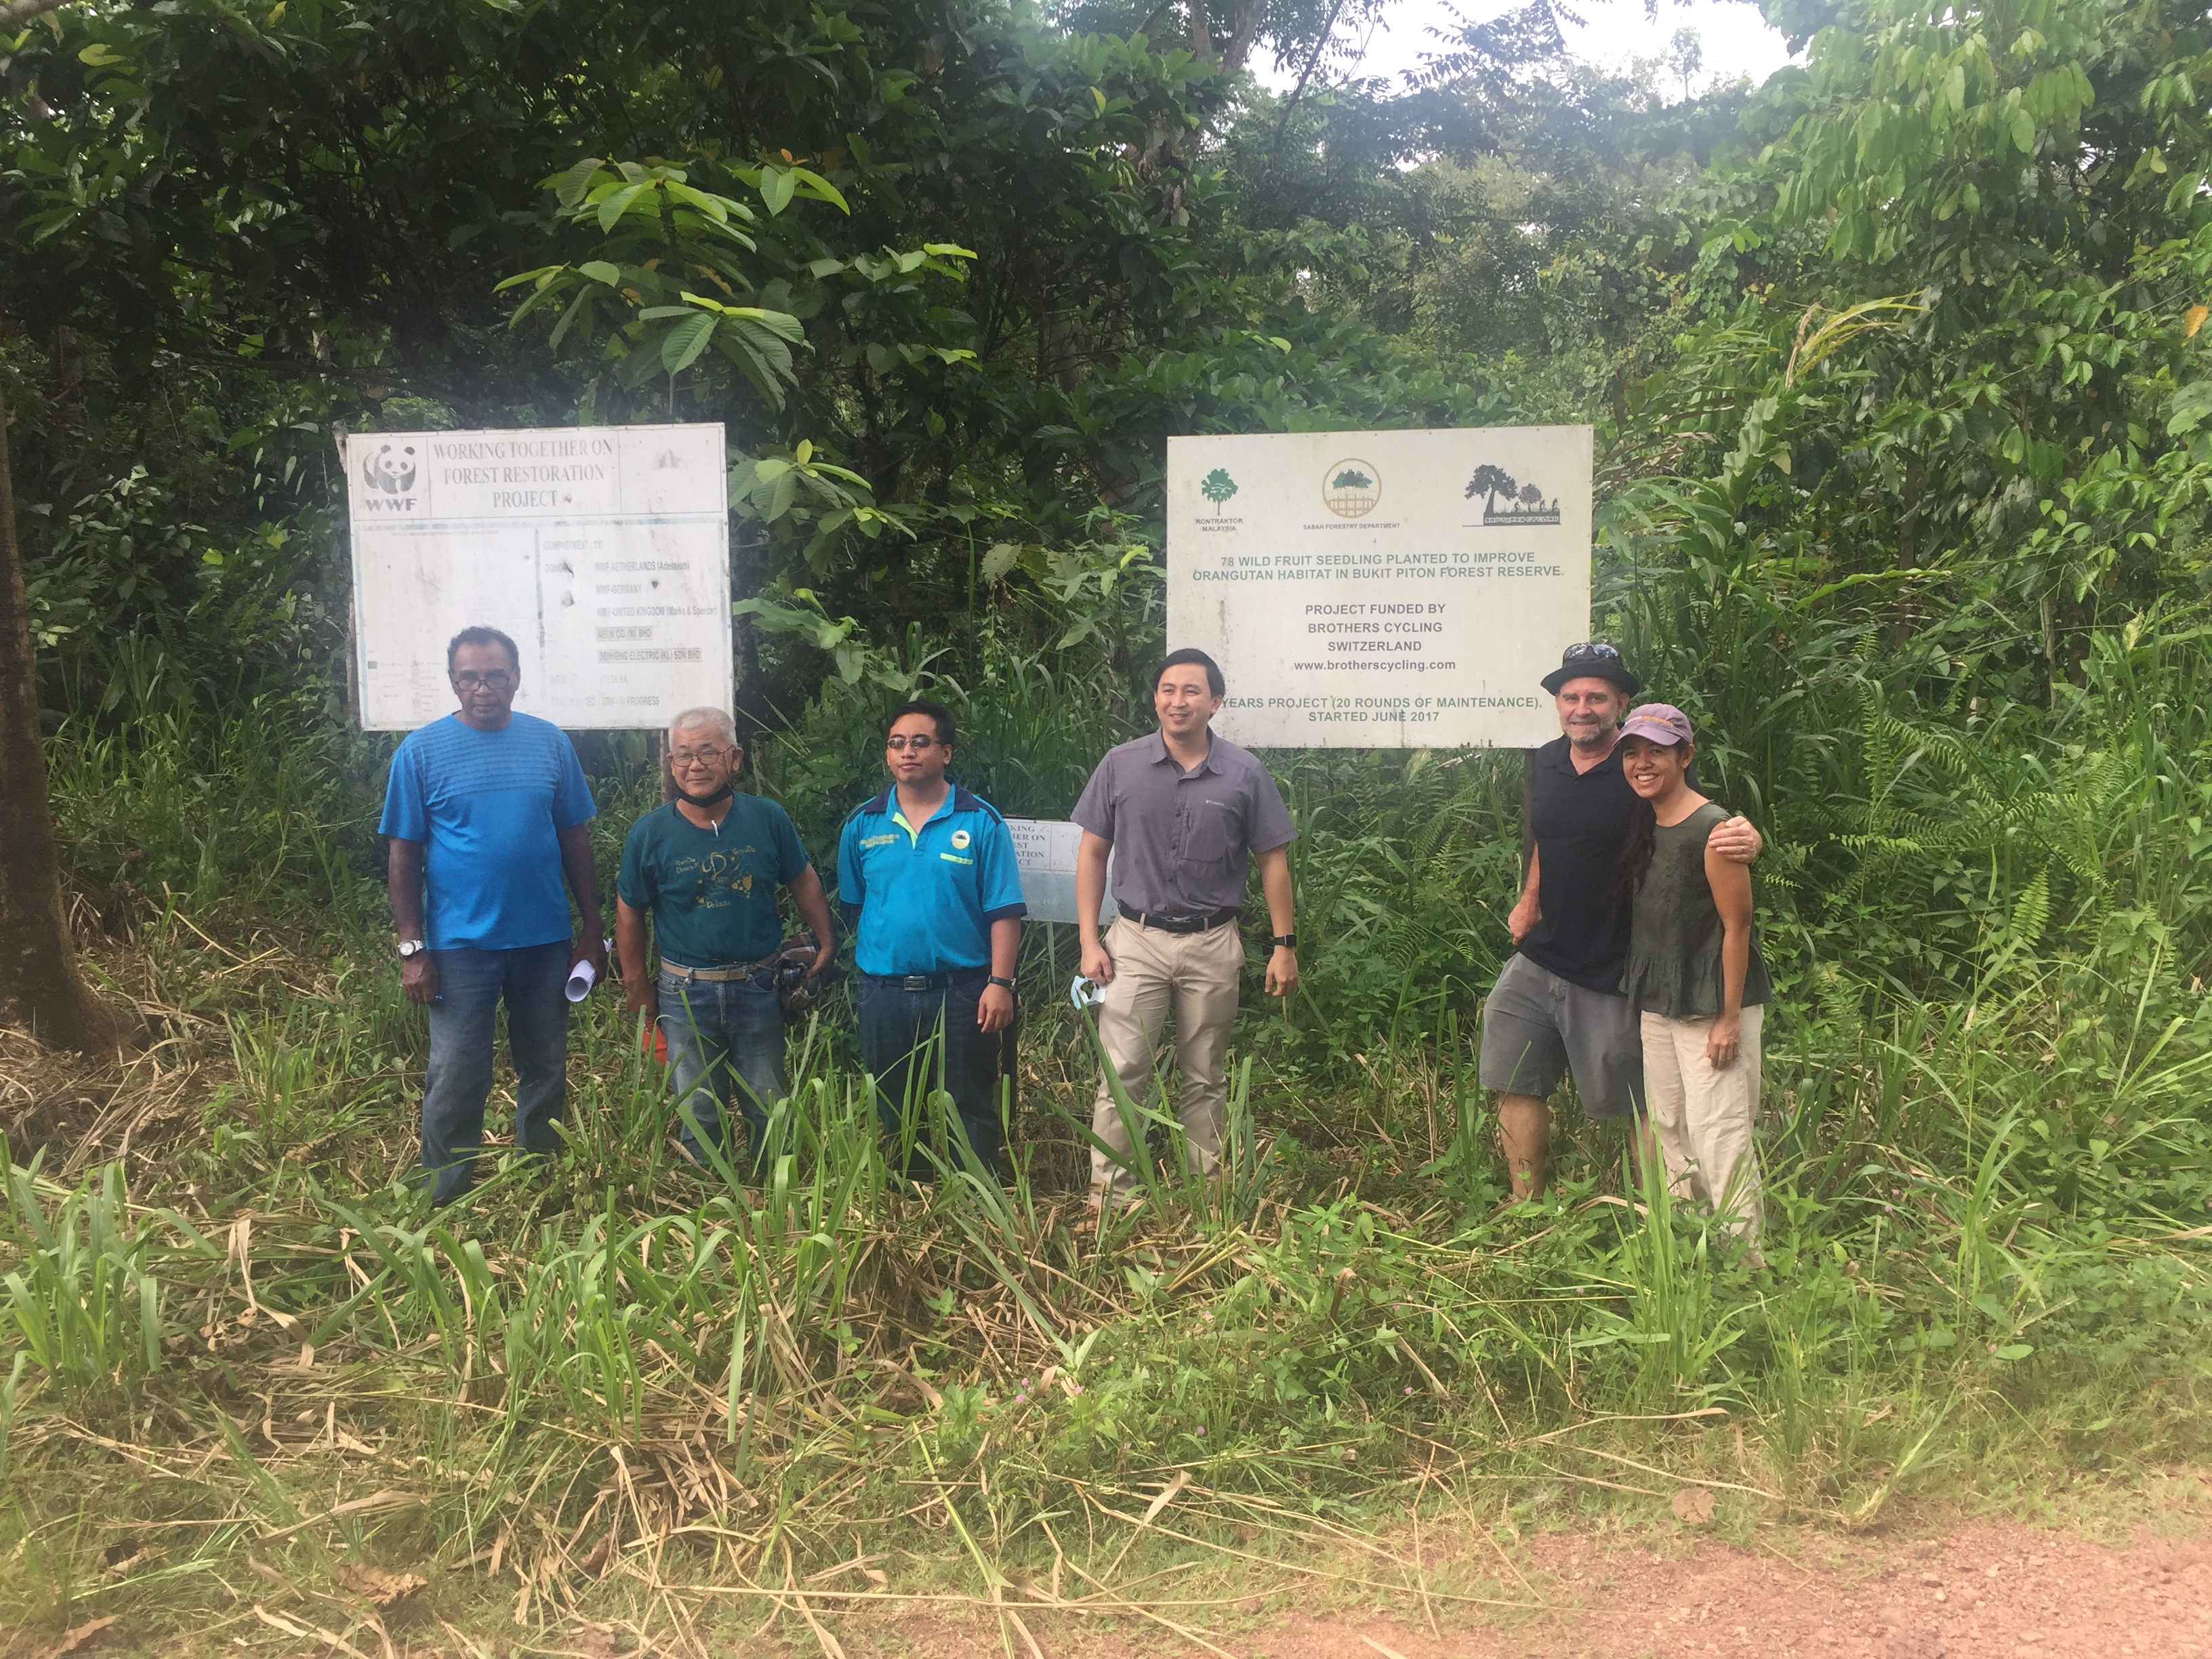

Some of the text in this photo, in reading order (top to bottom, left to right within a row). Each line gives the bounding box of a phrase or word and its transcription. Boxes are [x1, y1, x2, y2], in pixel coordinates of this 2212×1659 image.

[434, 439, 613, 459] WORKING TOGETHER ON
[444, 464, 606, 485] FOREST RESTORATION
[366, 498, 417, 512] WWF
[493, 491, 558, 508] PROJECT
[544, 540, 588, 550] COMPARTMENT
[1221, 552, 1535, 567] 78 WILD FRUIT SEEDLING PLANTED TO IMPROVE
[595, 561, 655, 571] WWF-NETHERLANDS
[1193, 565, 1564, 581] ORANGUTAN HABITAT IN BUKIT PITON FOREST RESERVE.
[596, 585, 642, 594] WWF-GERMANY
[597, 605, 718, 617] WWF-UNITED KINGDOM (Marks & Spencer)
[1305, 603, 1446, 615] PROJECT FUNDED BY
[598, 629, 615, 638] AEON
[638, 628, 651, 638] BHD
[1308, 622, 1442, 634] BROTHERS CYCLING
[1328, 641, 1422, 651] SWITZERLAND
[630, 651, 659, 660] ELECTRIC
[688, 649, 701, 659] BHD
[1294, 659, 1456, 672] www.brotherscycling.com
[627, 696, 660, 705] PROGRESS
[1223, 697, 1264, 708] YEARS
[1269, 697, 1328, 708] PROJECT
[1332, 697, 1351, 710] (20
[1355, 697, 1410, 708] ROUNDS
[1414, 697, 1432, 708] OF
[1309, 712, 1439, 722] STARTED JUNE 2017
